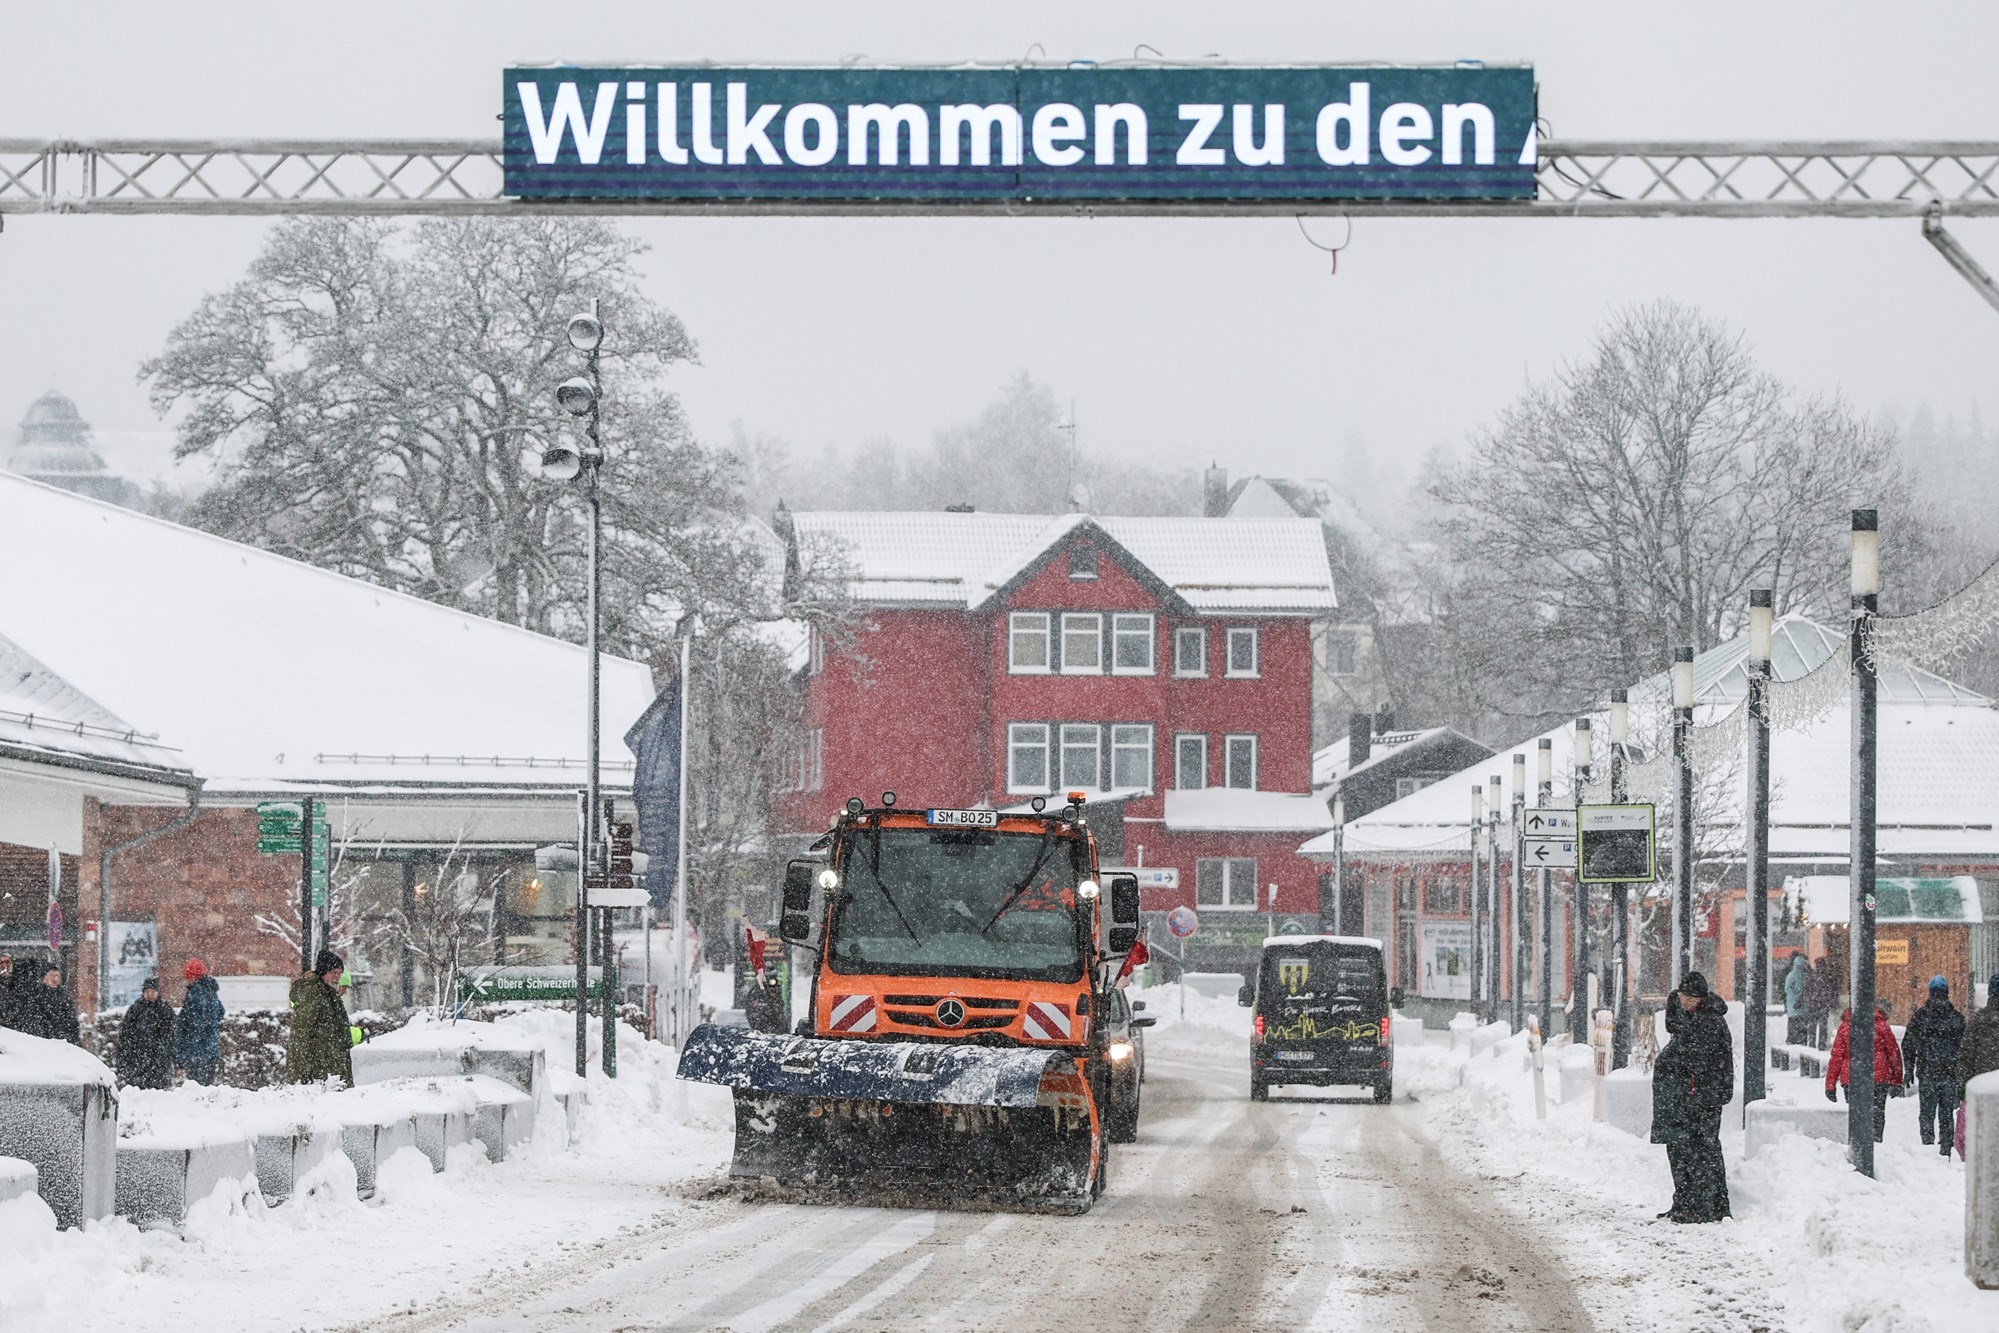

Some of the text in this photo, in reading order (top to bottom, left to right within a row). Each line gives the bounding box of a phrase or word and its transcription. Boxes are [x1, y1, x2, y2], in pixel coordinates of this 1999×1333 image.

[517, 81, 1148, 166] Willkommen
[1176, 103, 1286, 167] zu
[1315, 82, 1496, 167] den
[938, 811, 954, 823] SM
[977, 812, 992, 824] 25
[497, 977, 596, 990] Obere Schweizerhle
